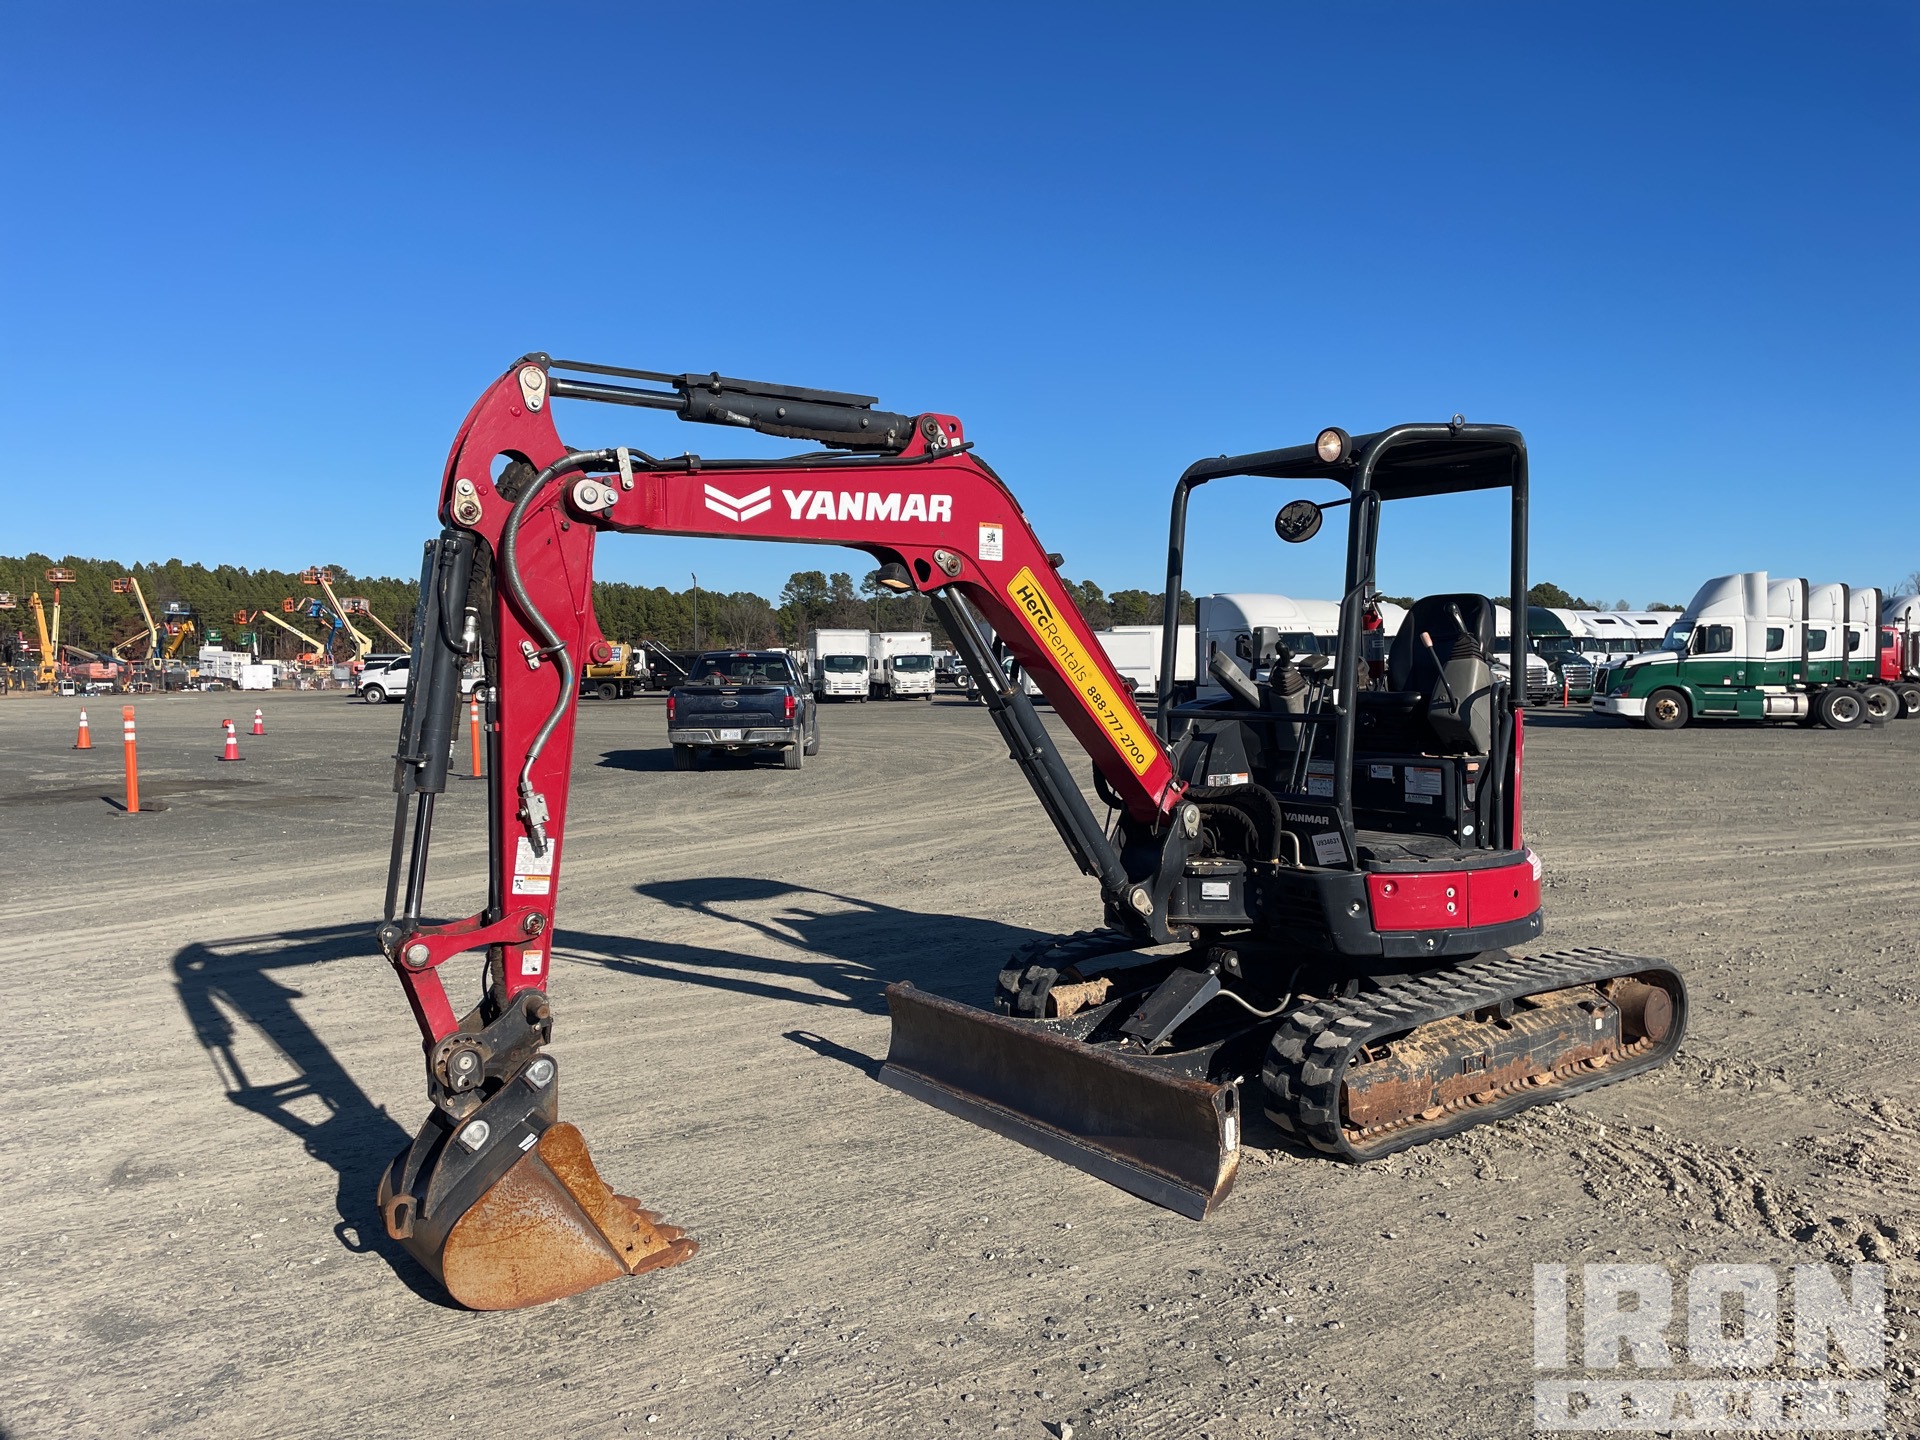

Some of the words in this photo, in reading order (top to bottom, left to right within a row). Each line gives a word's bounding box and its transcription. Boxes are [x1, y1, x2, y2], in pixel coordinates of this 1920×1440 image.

[782, 489, 953, 523] YANMAR
[1016, 585, 1087, 682] HercRentals
[1087, 685, 1145, 765] 888-777-2700
[1285, 812, 1330, 825] YANMAR
